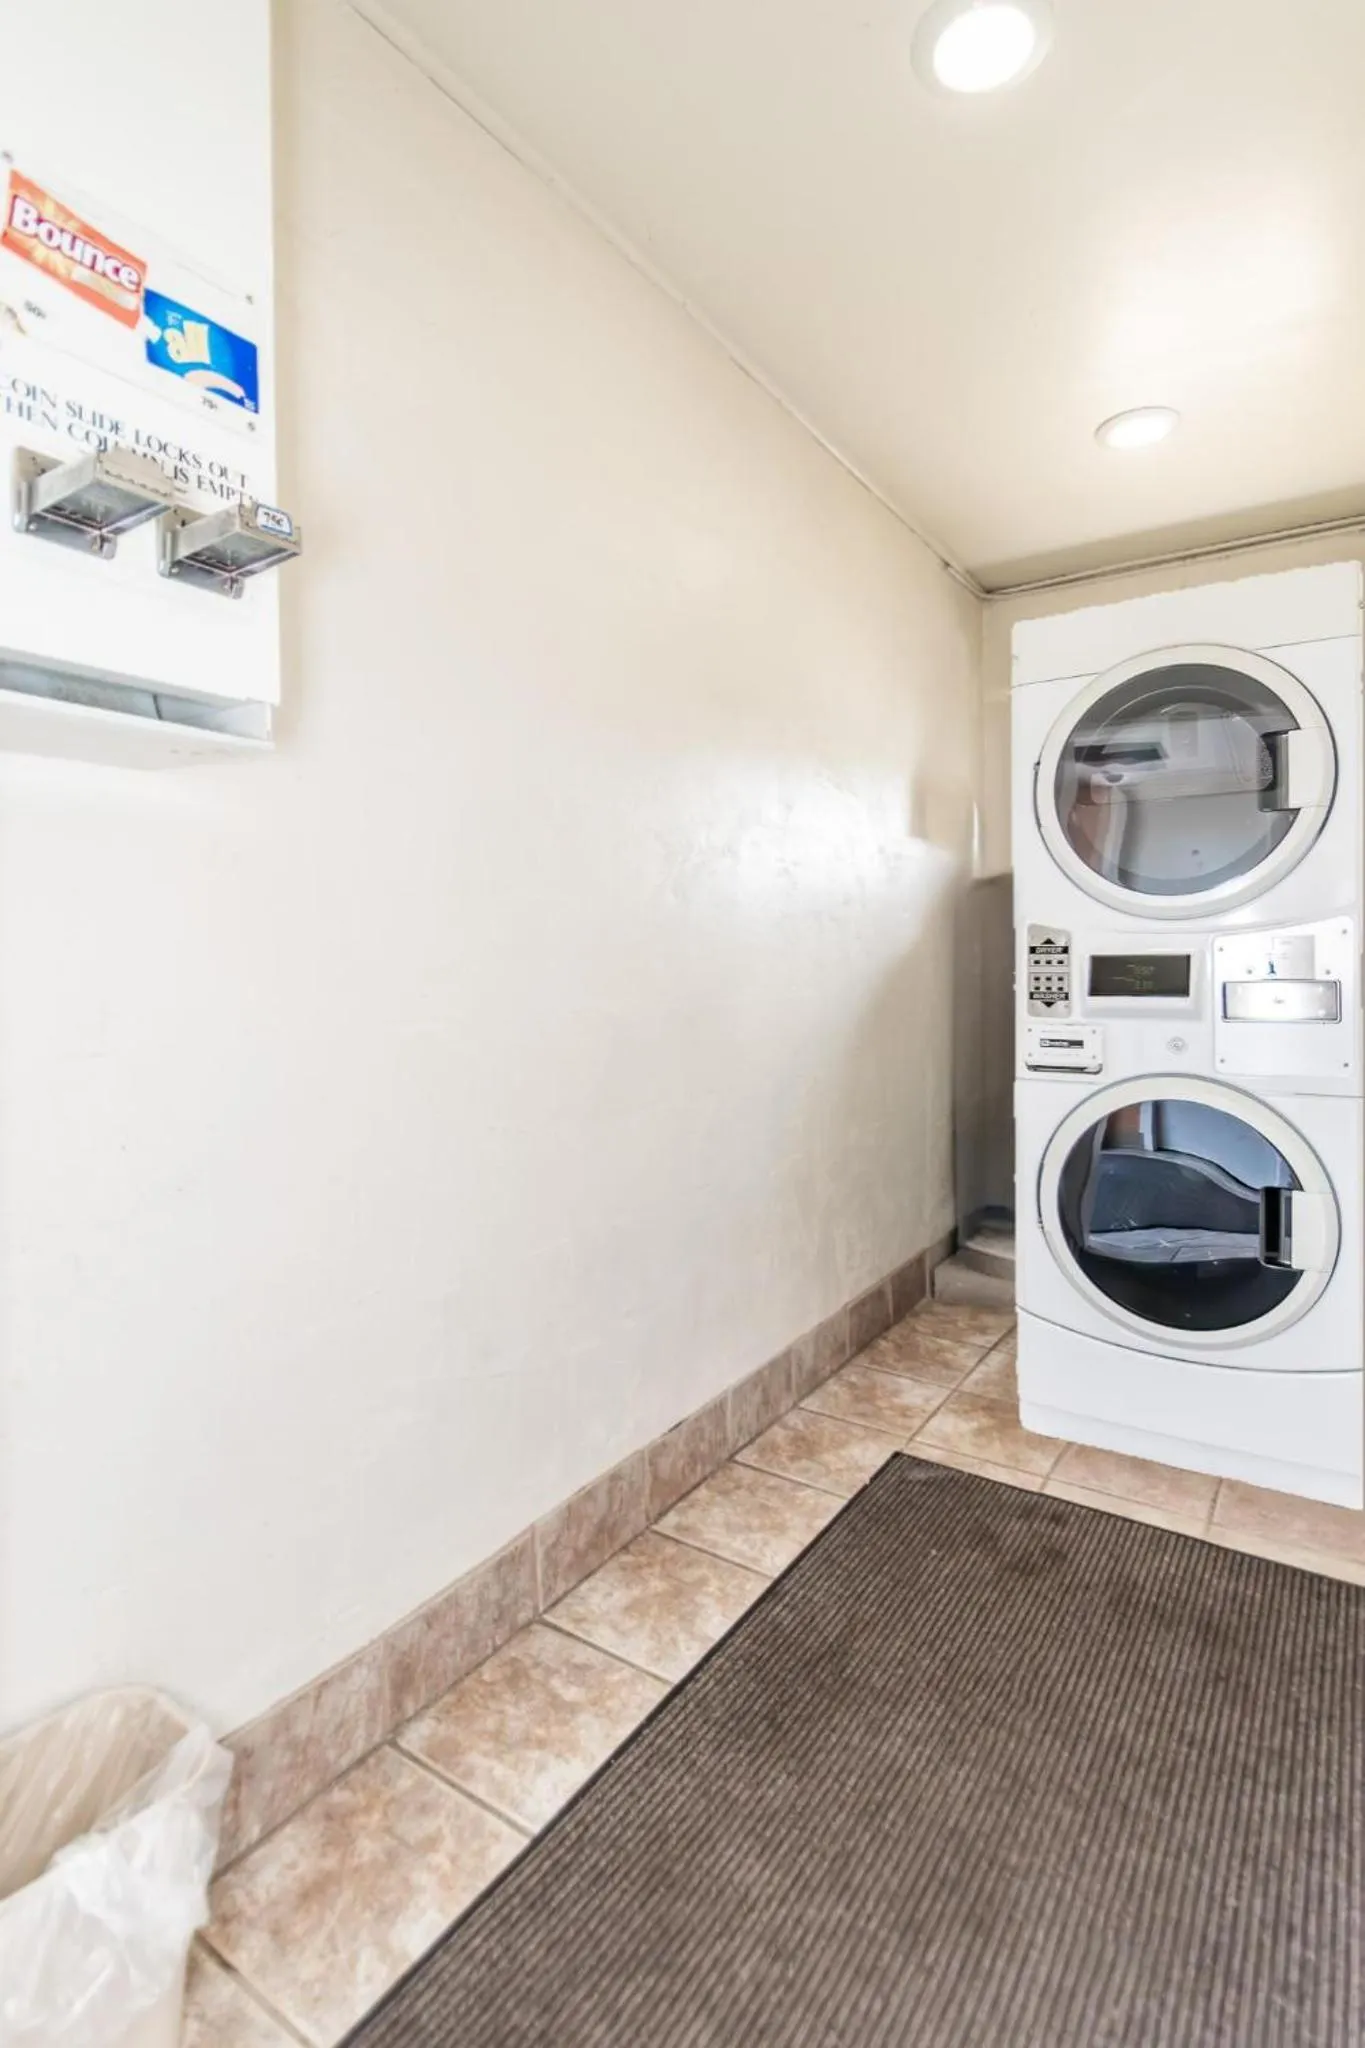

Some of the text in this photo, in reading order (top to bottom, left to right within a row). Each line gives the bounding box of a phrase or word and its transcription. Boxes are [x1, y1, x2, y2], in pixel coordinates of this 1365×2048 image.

[9, 194, 142, 293] Bounce
[163, 319, 211, 364] all
[0, 393, 58, 432] HEN
[173, 465, 189, 485] IS
[66, 400, 125, 438] SLIDE
[135, 429, 202, 469] LOCKS
[209, 461, 249, 489] OUT
